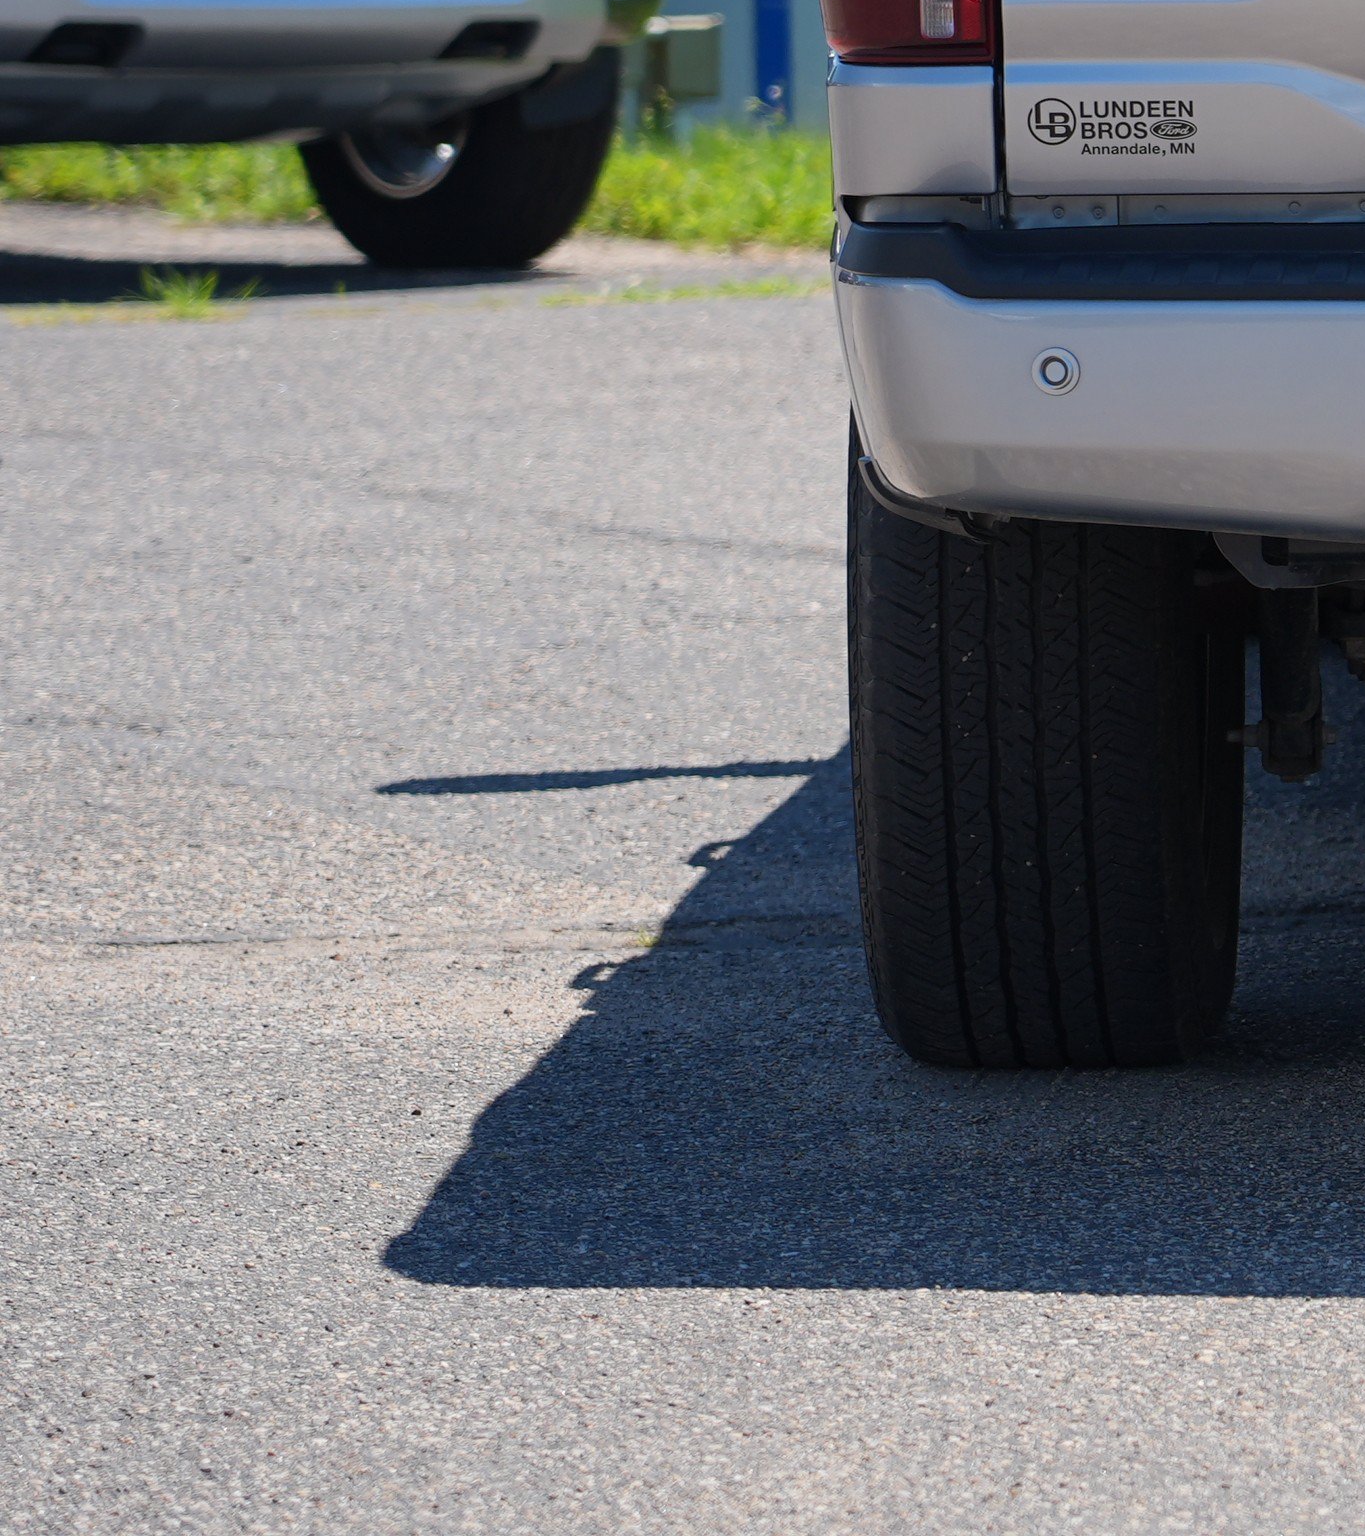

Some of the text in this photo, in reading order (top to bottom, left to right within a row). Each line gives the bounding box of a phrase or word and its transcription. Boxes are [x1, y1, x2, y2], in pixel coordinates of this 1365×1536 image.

[1080, 101, 1194, 118] LUNDEEN
[1081, 122, 1148, 139] BROS
[1081, 143, 1195, 156] Annandale, MN
